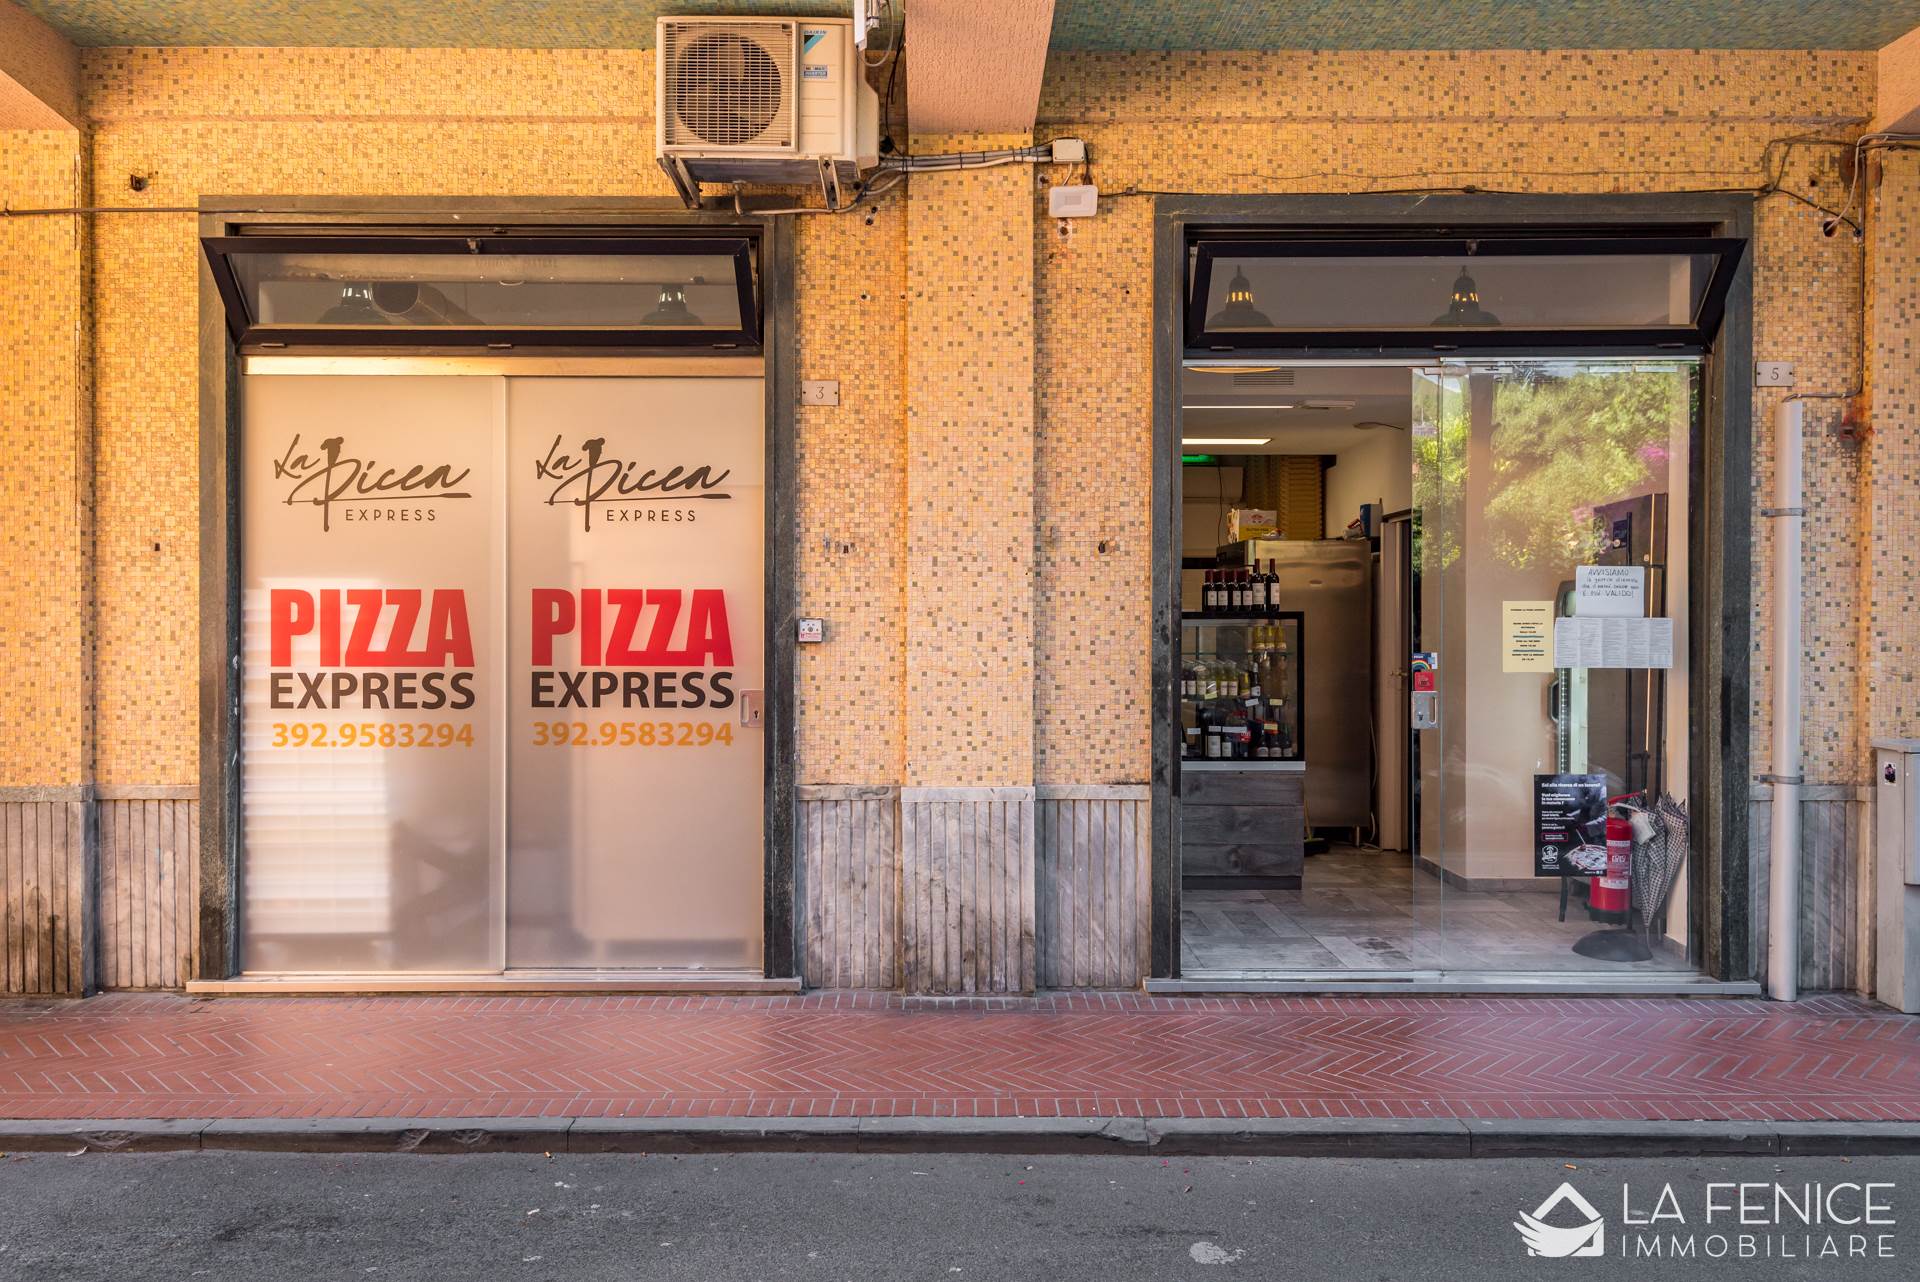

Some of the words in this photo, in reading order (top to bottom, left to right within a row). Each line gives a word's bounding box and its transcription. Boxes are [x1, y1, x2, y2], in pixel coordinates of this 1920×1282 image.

[1771, 368, 1779, 380] 5
[816, 387, 824, 399] 3
[273, 433, 320, 480] La
[535, 433, 582, 480] La
[345, 508, 437, 522] EXPRESS
[606, 508, 697, 522] EXPRESS
[1588, 567, 1629, 577] AVVISIAMO
[270, 588, 475, 667] PIZZA
[531, 588, 734, 667] PIZZA
[270, 672, 475, 710] EXPRESS
[531, 671, 734, 709] EXPRESS
[271, 722, 474, 749] 392.9583294
[532, 721, 733, 747] 392.9583294
